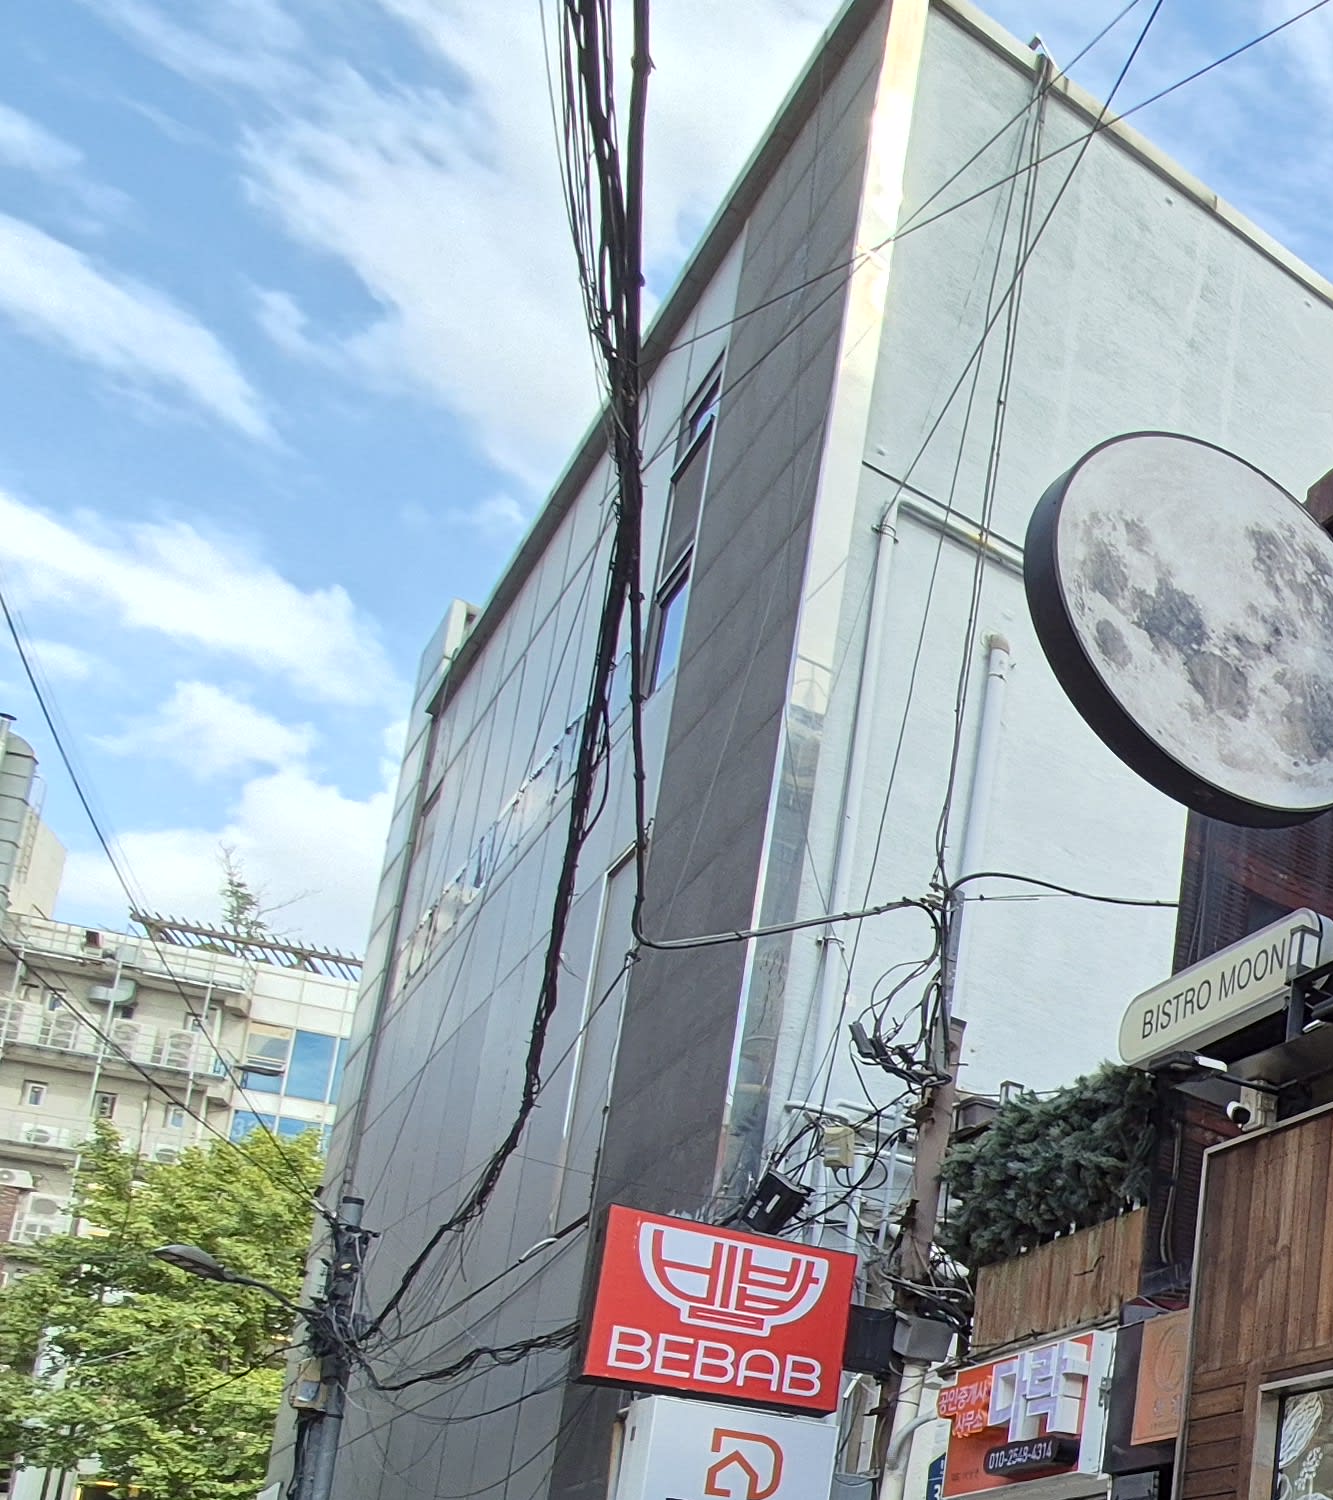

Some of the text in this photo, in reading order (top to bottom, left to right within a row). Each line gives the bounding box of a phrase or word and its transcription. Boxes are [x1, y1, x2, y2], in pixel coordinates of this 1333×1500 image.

[1141, 938, 1287, 1041] BISTRO MOON
[606, 1324, 822, 1397] BEBAB
[938, 1378, 990, 1413] 공인중개사
[954, 1410, 985, 1433] 사무소
